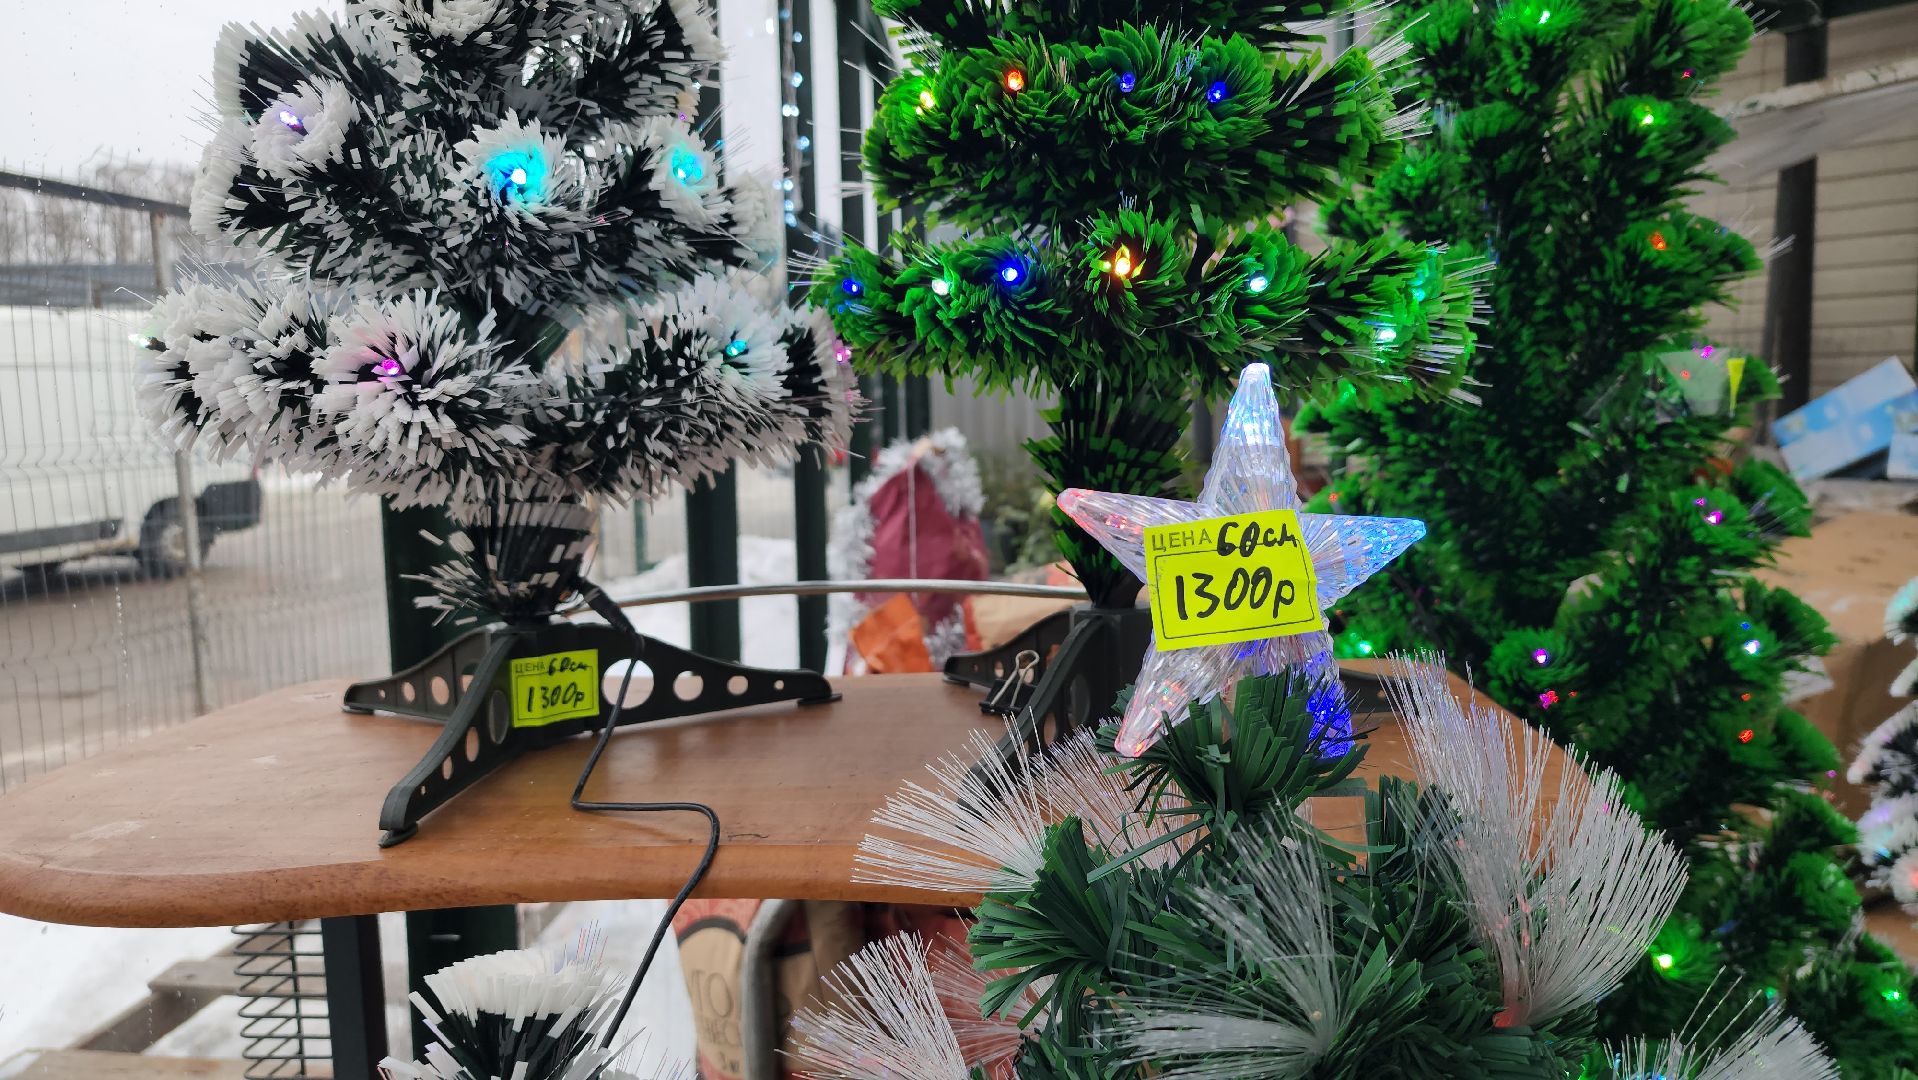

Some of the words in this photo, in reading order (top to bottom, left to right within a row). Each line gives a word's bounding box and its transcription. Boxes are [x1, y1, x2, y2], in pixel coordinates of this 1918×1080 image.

[1151, 528, 1212, 552] ЦЕНА
[1175, 566, 1295, 620] 1300р
[515, 661, 546, 674] ЦЕНА
[527, 681, 585, 713] 1300р
